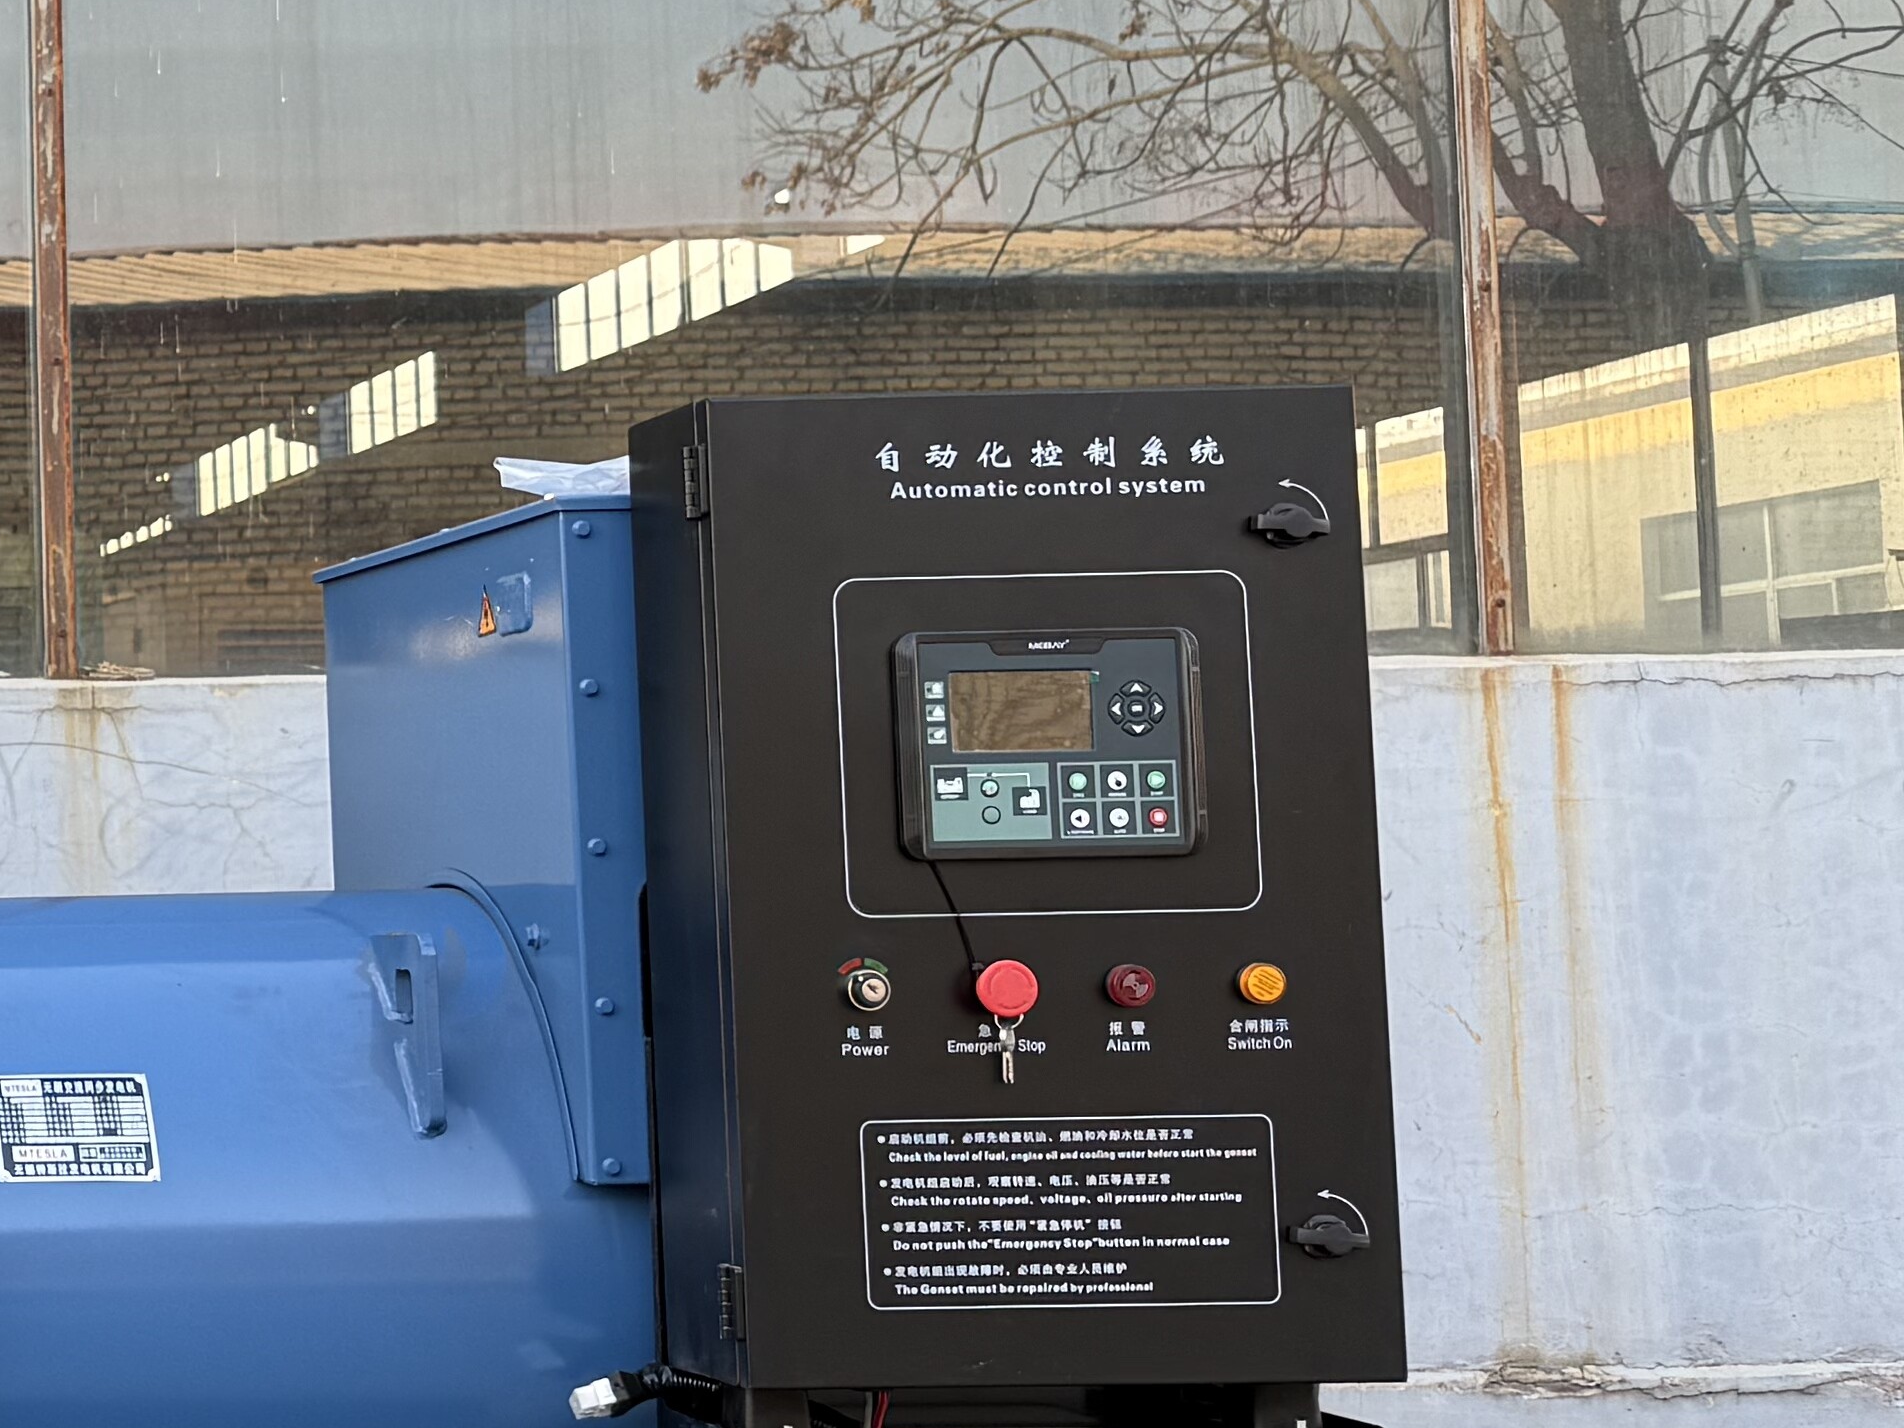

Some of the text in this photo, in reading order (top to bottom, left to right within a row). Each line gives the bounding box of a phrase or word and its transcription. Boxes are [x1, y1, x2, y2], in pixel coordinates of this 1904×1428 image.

[874, 434, 1225, 473] 自动化控制系统
[890, 476, 1206, 500] Automatic control system
[846, 1025, 883, 1041] 电源
[1109, 1020, 1146, 1036] 报警
[1229, 1018, 1289, 1034] 合闸指示
[841, 1043, 890, 1057] Power
[946, 1037, 1047, 1057] Emergen Stop
[1105, 1038, 1151, 1052] Alarm
[1227, 1035, 1293, 1050] Switch On
[888, 1151, 922, 1163] Check
[923, 1151, 942, 1162] the
[943, 1150, 970, 1162] level
[971, 1150, 983, 1162] of
[1010, 1151, 1044, 1163] engine
[1045, 1150, 1058, 1161] oil
[1059, 1150, 1079, 1160] and
[1079, 1149, 1116, 1161] cooling
[1117, 1149, 1146, 1159] water
[1147, 1148, 1180, 1159] before
[1180, 1148, 1205, 1158] start
[1205, 1148, 1223, 1158] the
[890, 1195, 929, 1207] Check
[929, 1195, 951, 1206] the
[952, 1195, 991, 1206] rotate
[1096, 1192, 1113, 1204] oil
[1114, 1193, 1169, 1205] pressure
[1170, 1192, 1197, 1203] after
[1198, 1191, 1243, 1203] starting
[892, 1239, 911, 1251] Do
[911, 1240, 934, 1251] not
[935, 1239, 966, 1252] push
[1142, 1235, 1155, 1247] in
[1156, 1235, 1201, 1247] normal
[1201, 1237, 1230, 1246] case
[894, 1283, 919, 1295] The
[965, 1284, 997, 1294] must
[998, 1283, 1015, 1294] be
[1016, 1281, 1069, 1296] repaired
[1069, 1282, 1085, 1294] by
[1085, 1281, 1154, 1294] professional
